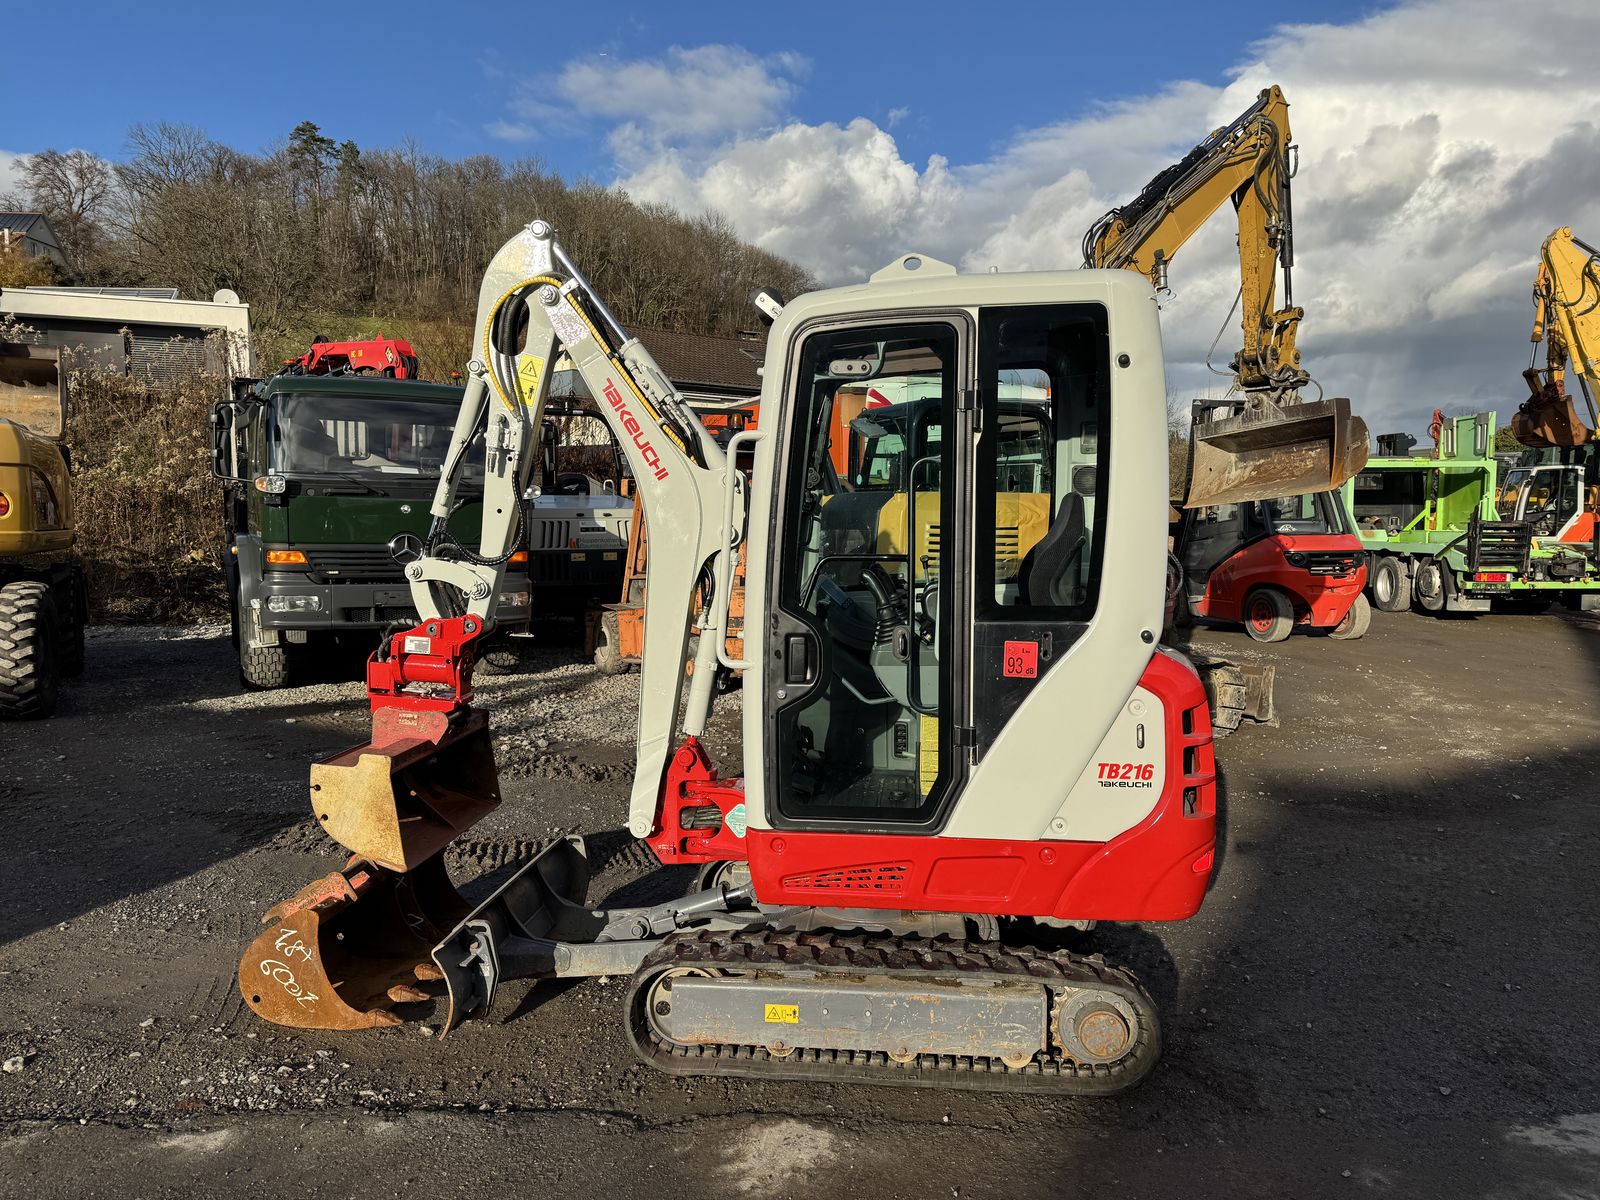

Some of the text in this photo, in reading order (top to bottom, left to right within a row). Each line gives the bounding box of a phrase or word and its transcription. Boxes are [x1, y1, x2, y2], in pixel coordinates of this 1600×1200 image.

[1007, 656, 1023, 674] 93
[1097, 762, 1155, 781] TB216
[1097, 780, 1152, 788] TAKEUCHI
